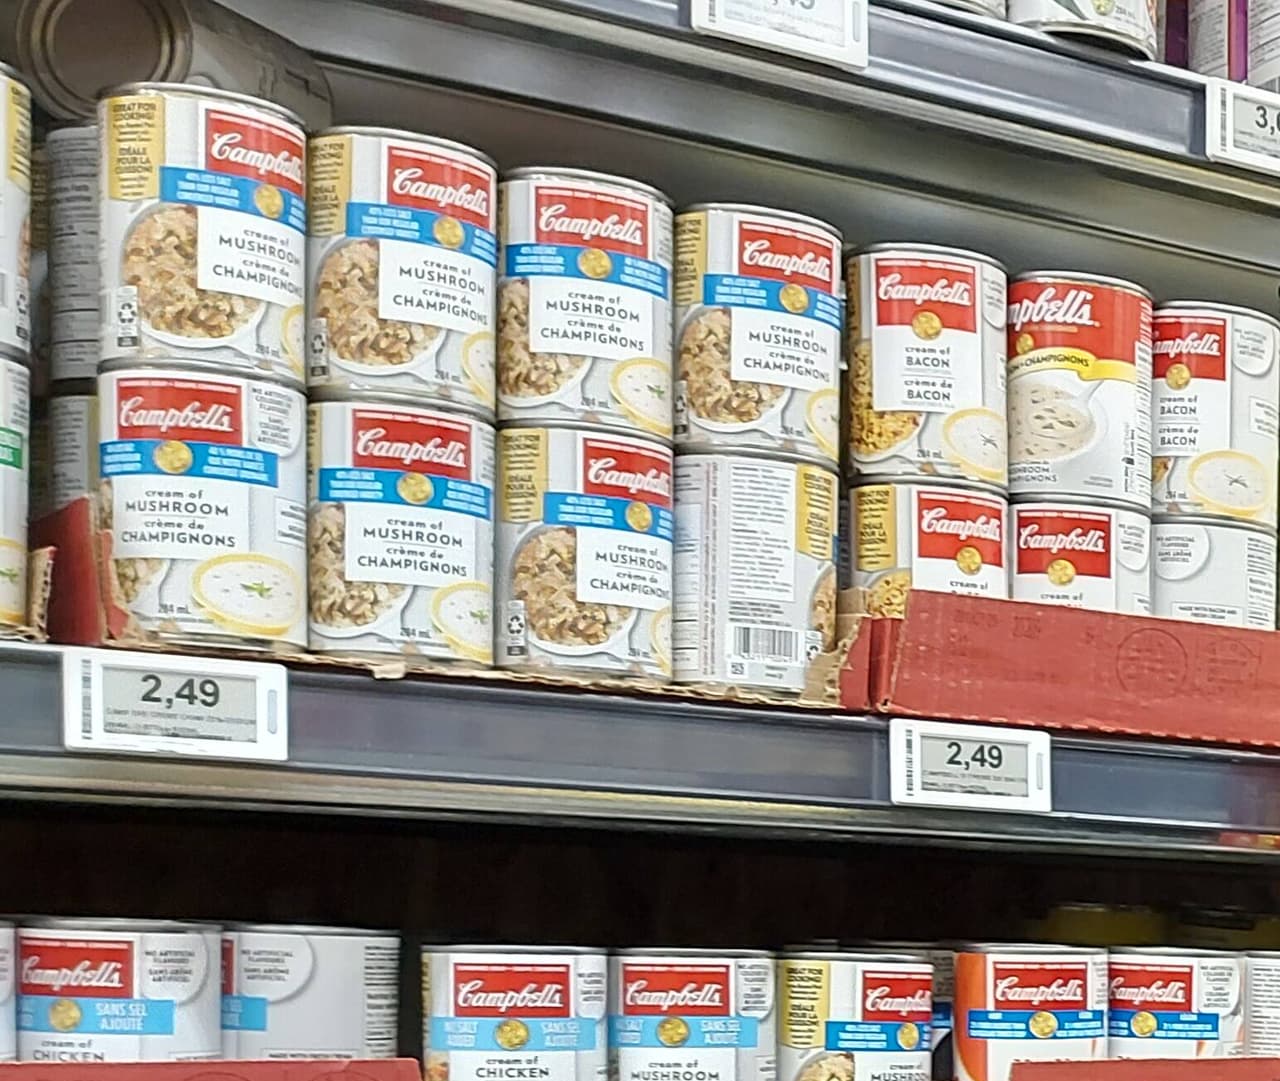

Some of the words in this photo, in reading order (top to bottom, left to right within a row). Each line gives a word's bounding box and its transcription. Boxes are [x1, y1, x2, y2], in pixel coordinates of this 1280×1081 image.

[393, 166, 489, 217] Campbell's
[539, 204, 643, 247] Campbell's
[423, 259, 450, 273] cream
[743, 240, 831, 283] Campbell's
[400, 266, 486, 295] MUSHROOM
[568, 291, 605, 303] cream
[609, 296, 621, 305] of
[878, 274, 971, 306] Campbell's
[393, 295, 488, 325] CHAMPIGNONS
[545, 301, 640, 324] MUSHROOM
[567, 319, 603, 332] crème
[770, 323, 797, 336] cream
[541, 328, 644, 352] CHAMPIGNONS
[749, 332, 827, 355] MUSHROOM
[905, 346, 936, 356] cream
[906, 355, 950, 368] BACON
[743, 357, 830, 383] CHAMPIGNONS
[905, 380, 935, 390] crème
[907, 389, 951, 401] BACON
[1160, 396, 1187, 405] cream
[121, 396, 233, 433] Campbell's
[1160, 405, 1196, 415] BACON
[356, 428, 466, 468] Campbell's
[1160, 436, 1196, 446] BACON
[145, 489, 185, 499] cream
[189, 489, 203, 500] of
[125, 501, 229, 517] MUSHROOM
[145, 518, 185, 531] crème
[189, 520, 204, 531] de
[387, 517, 427, 529] cream
[430, 520, 443, 531] of
[121, 531, 236, 548] CHAMPIGNONS
[363, 527, 463, 547] MUSHROOM
[1019, 522, 1106, 554] Campbell's
[386, 546, 425, 558] crème
[358, 556, 467, 577] CHAMPIGNONS
[141, 674, 220, 708] 2,49
[947, 742, 1002, 770] 2,49
[22, 956, 124, 991] Campbell's
[457, 980, 563, 1009] Campbell's
[626, 981, 724, 1009] Campbell's
[996, 977, 1084, 1003] Campbell's
[96, 1003, 123, 1016] SANS
[42, 1039, 77, 1050] cream
[33, 1050, 104, 1062] CHICKEN
[485, 1058, 518, 1066] cream
[476, 1067, 549, 1079] CHICKEN
[648, 1062, 680, 1070] cream
[631, 1070, 721, 1081] MUSHROOM
